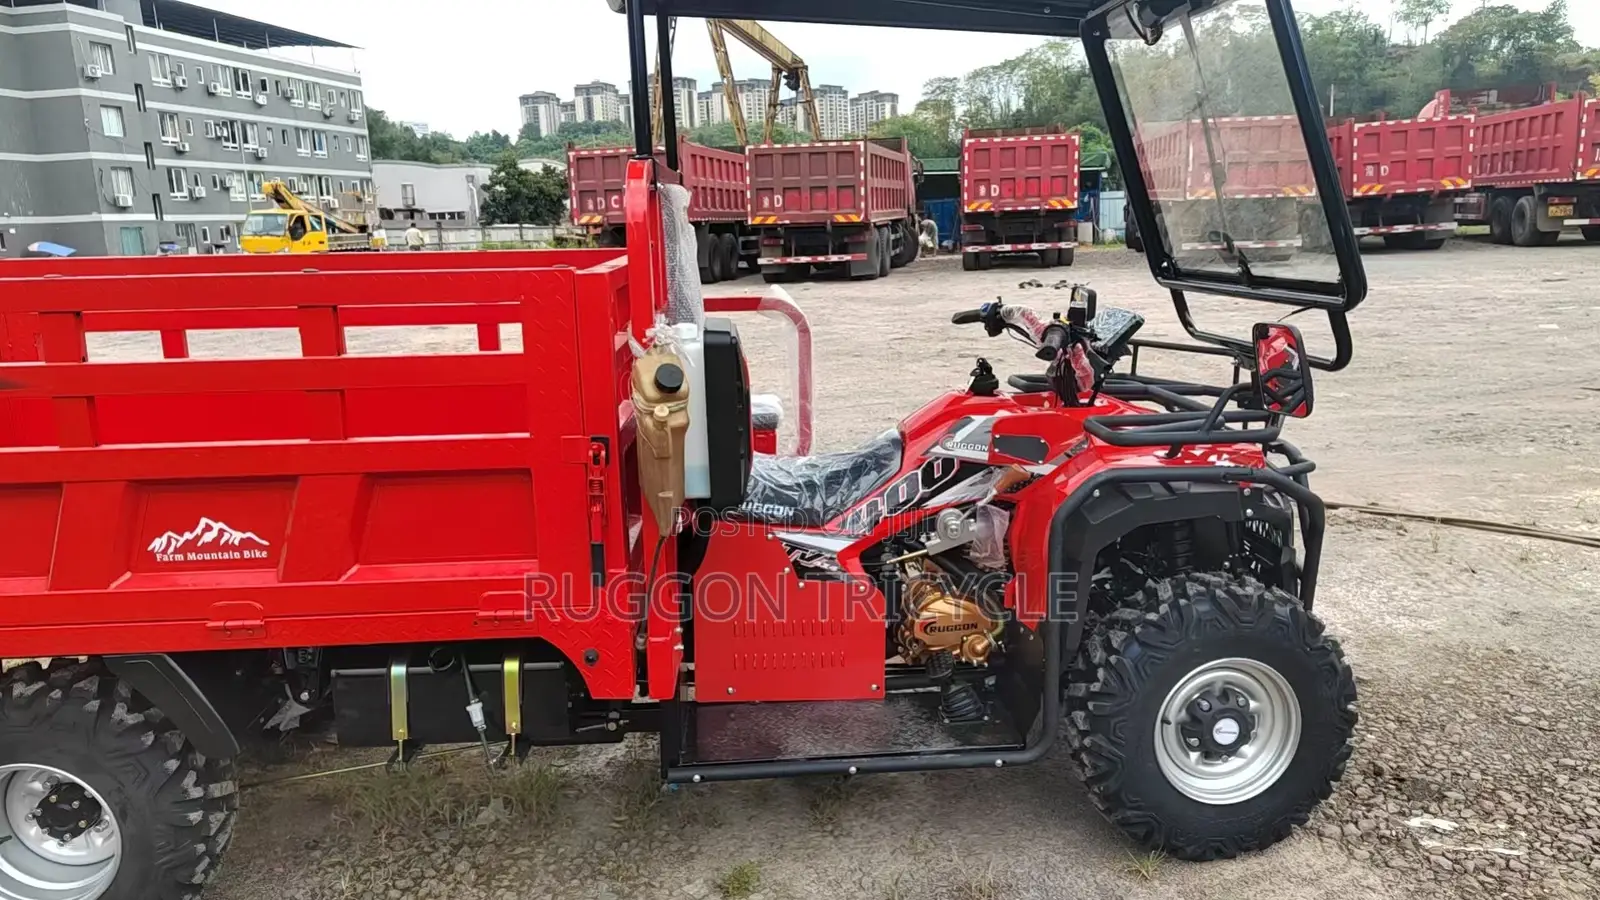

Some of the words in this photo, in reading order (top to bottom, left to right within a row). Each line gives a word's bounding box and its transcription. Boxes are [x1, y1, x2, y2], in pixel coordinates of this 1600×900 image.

[738, 501, 795, 517] UGGON
[156, 553, 184, 562] Farm
[187, 550, 241, 561] Mountain
[243, 548, 268, 559] Bike
[928, 622, 979, 634] RUGGON
